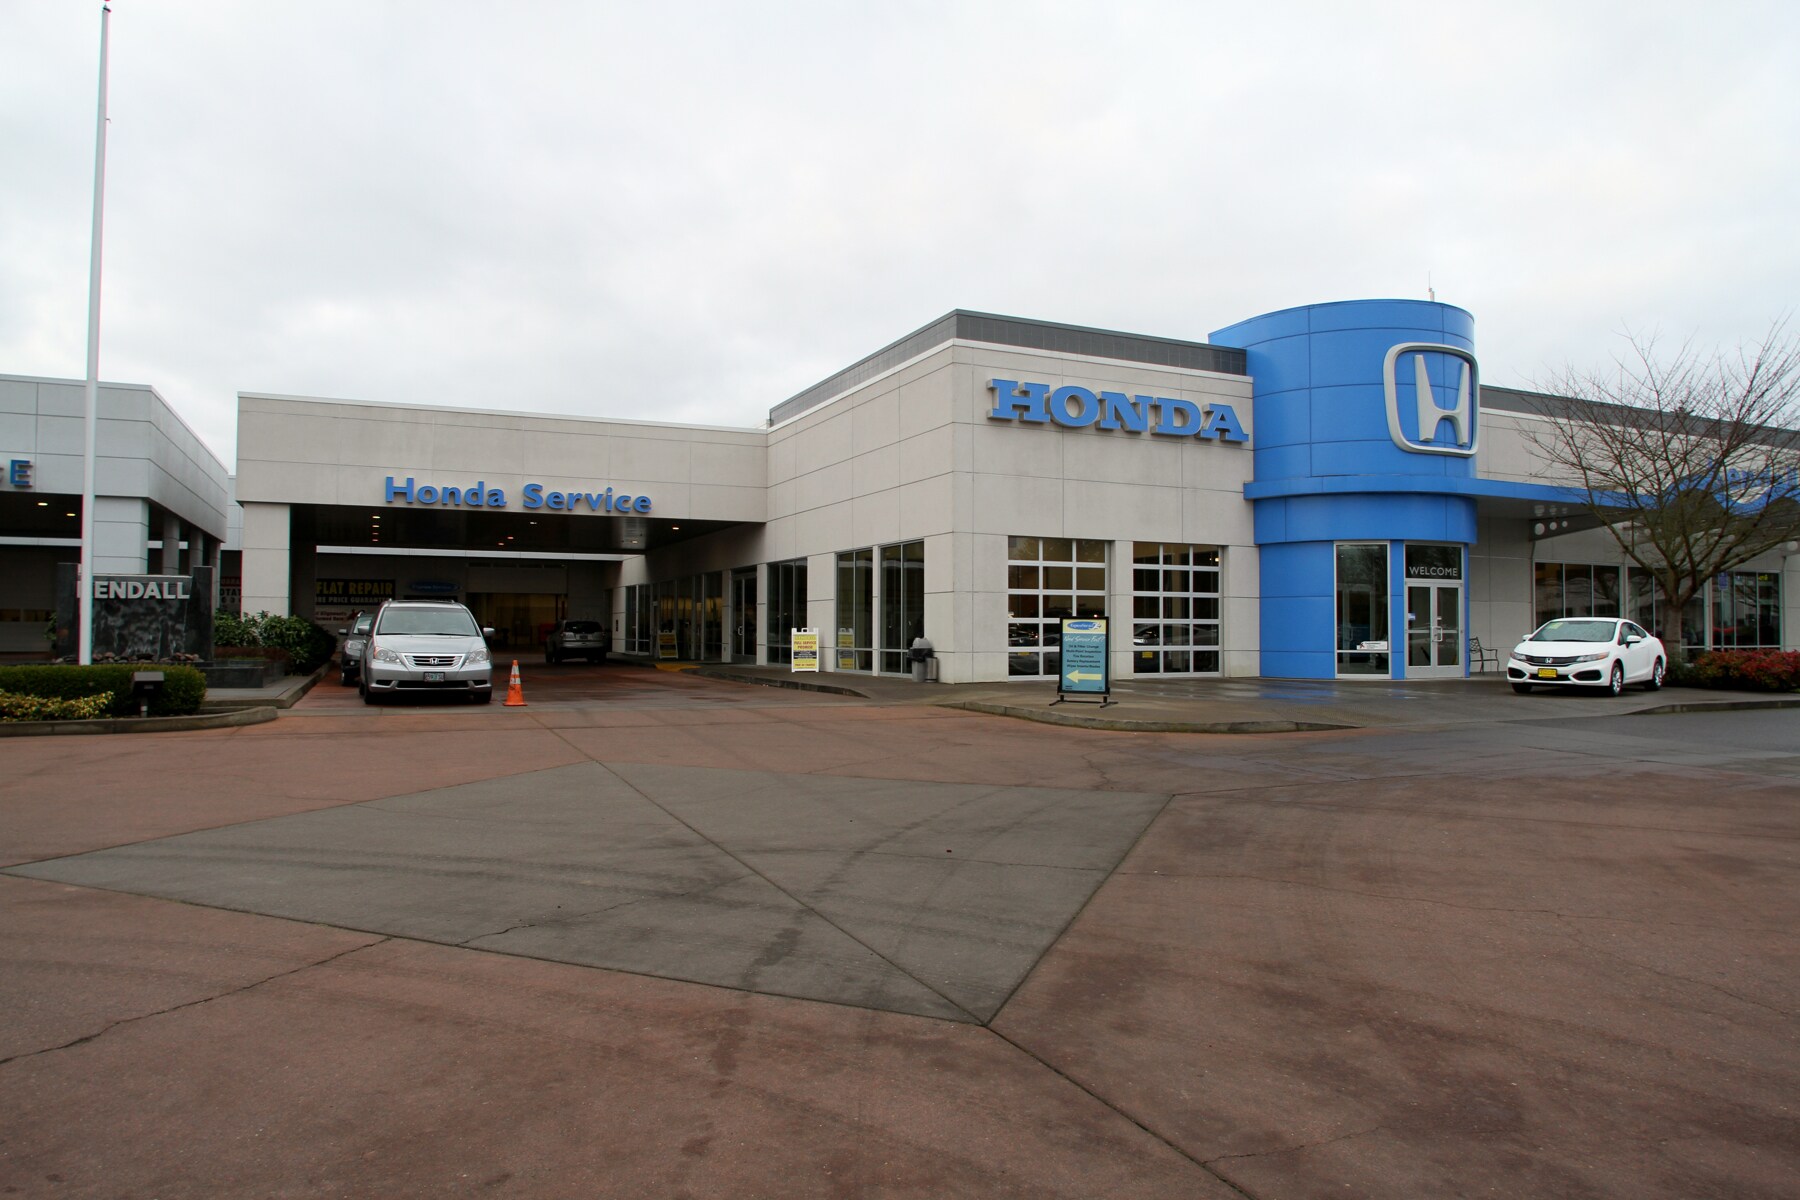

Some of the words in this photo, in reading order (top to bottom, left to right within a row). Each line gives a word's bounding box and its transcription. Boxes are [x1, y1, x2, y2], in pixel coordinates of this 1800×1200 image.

[987, 379, 1249, 443] HONDA
[385, 476, 507, 507] Honda
[522, 483, 652, 513] Service
[1408, 566, 1458, 577] WELCOME
[316, 581, 345, 594] FLAT
[348, 581, 393, 595] REPAIR
